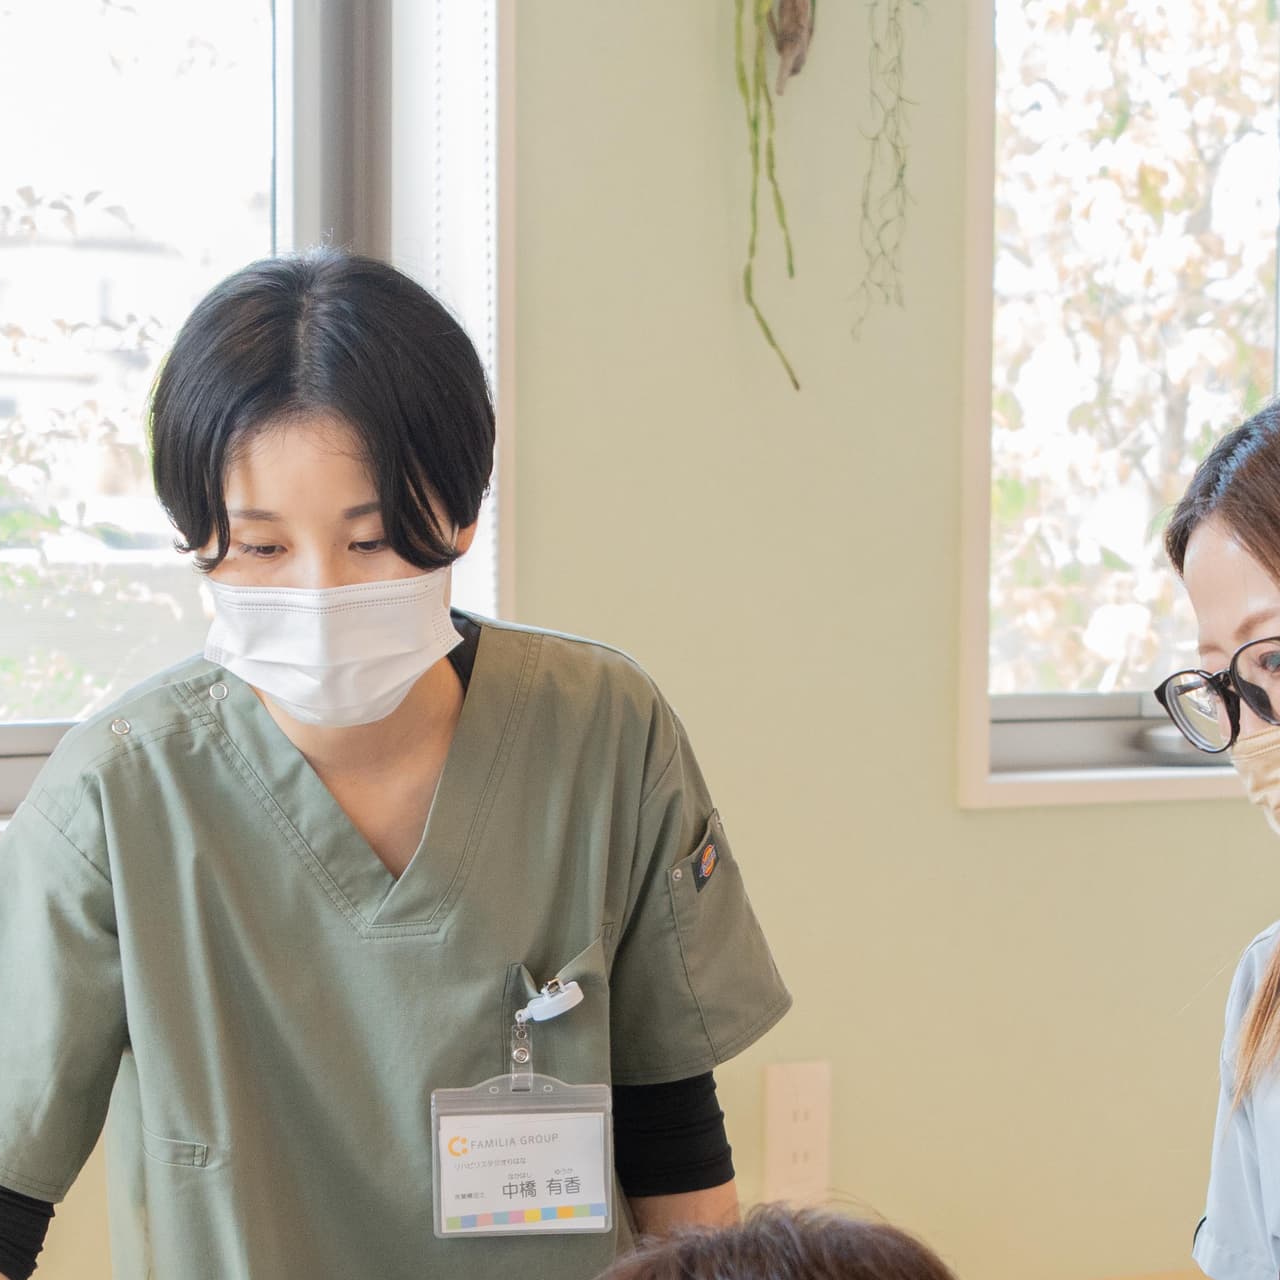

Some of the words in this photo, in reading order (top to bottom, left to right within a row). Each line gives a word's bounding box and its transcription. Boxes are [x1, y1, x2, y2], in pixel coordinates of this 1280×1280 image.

[471, 1138, 516, 1150] FAMILIA
[520, 1133, 559, 1145] GROUP
[502, 1180, 537, 1200] 中橋
[546, 1176, 582, 1196] 有香
